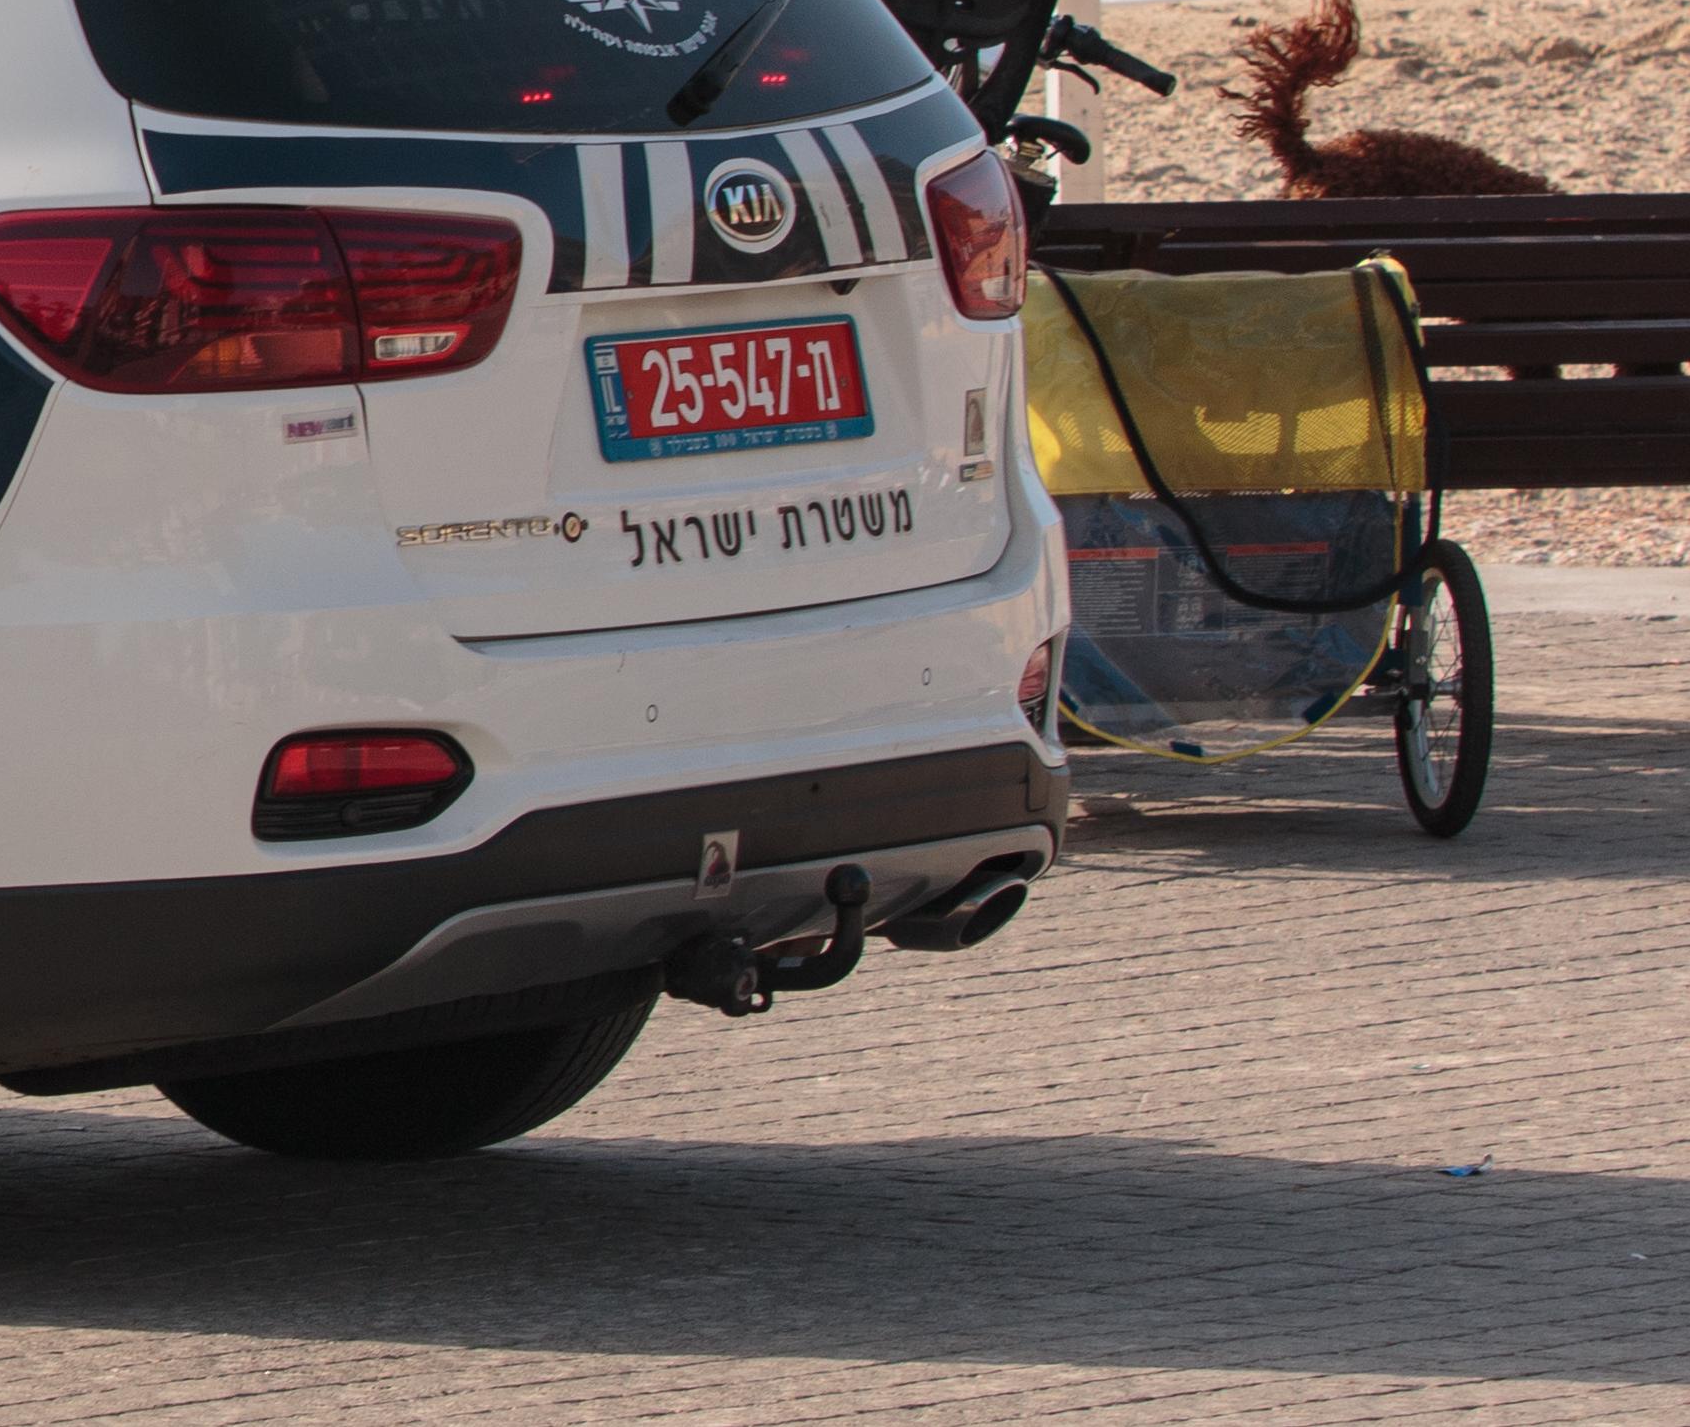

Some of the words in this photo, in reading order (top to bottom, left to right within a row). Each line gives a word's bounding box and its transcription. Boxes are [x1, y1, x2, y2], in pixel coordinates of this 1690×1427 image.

[722, 183, 785, 225] KIA
[621, 509, 757, 569] ישראל
[778, 487, 914, 550] משטרת
